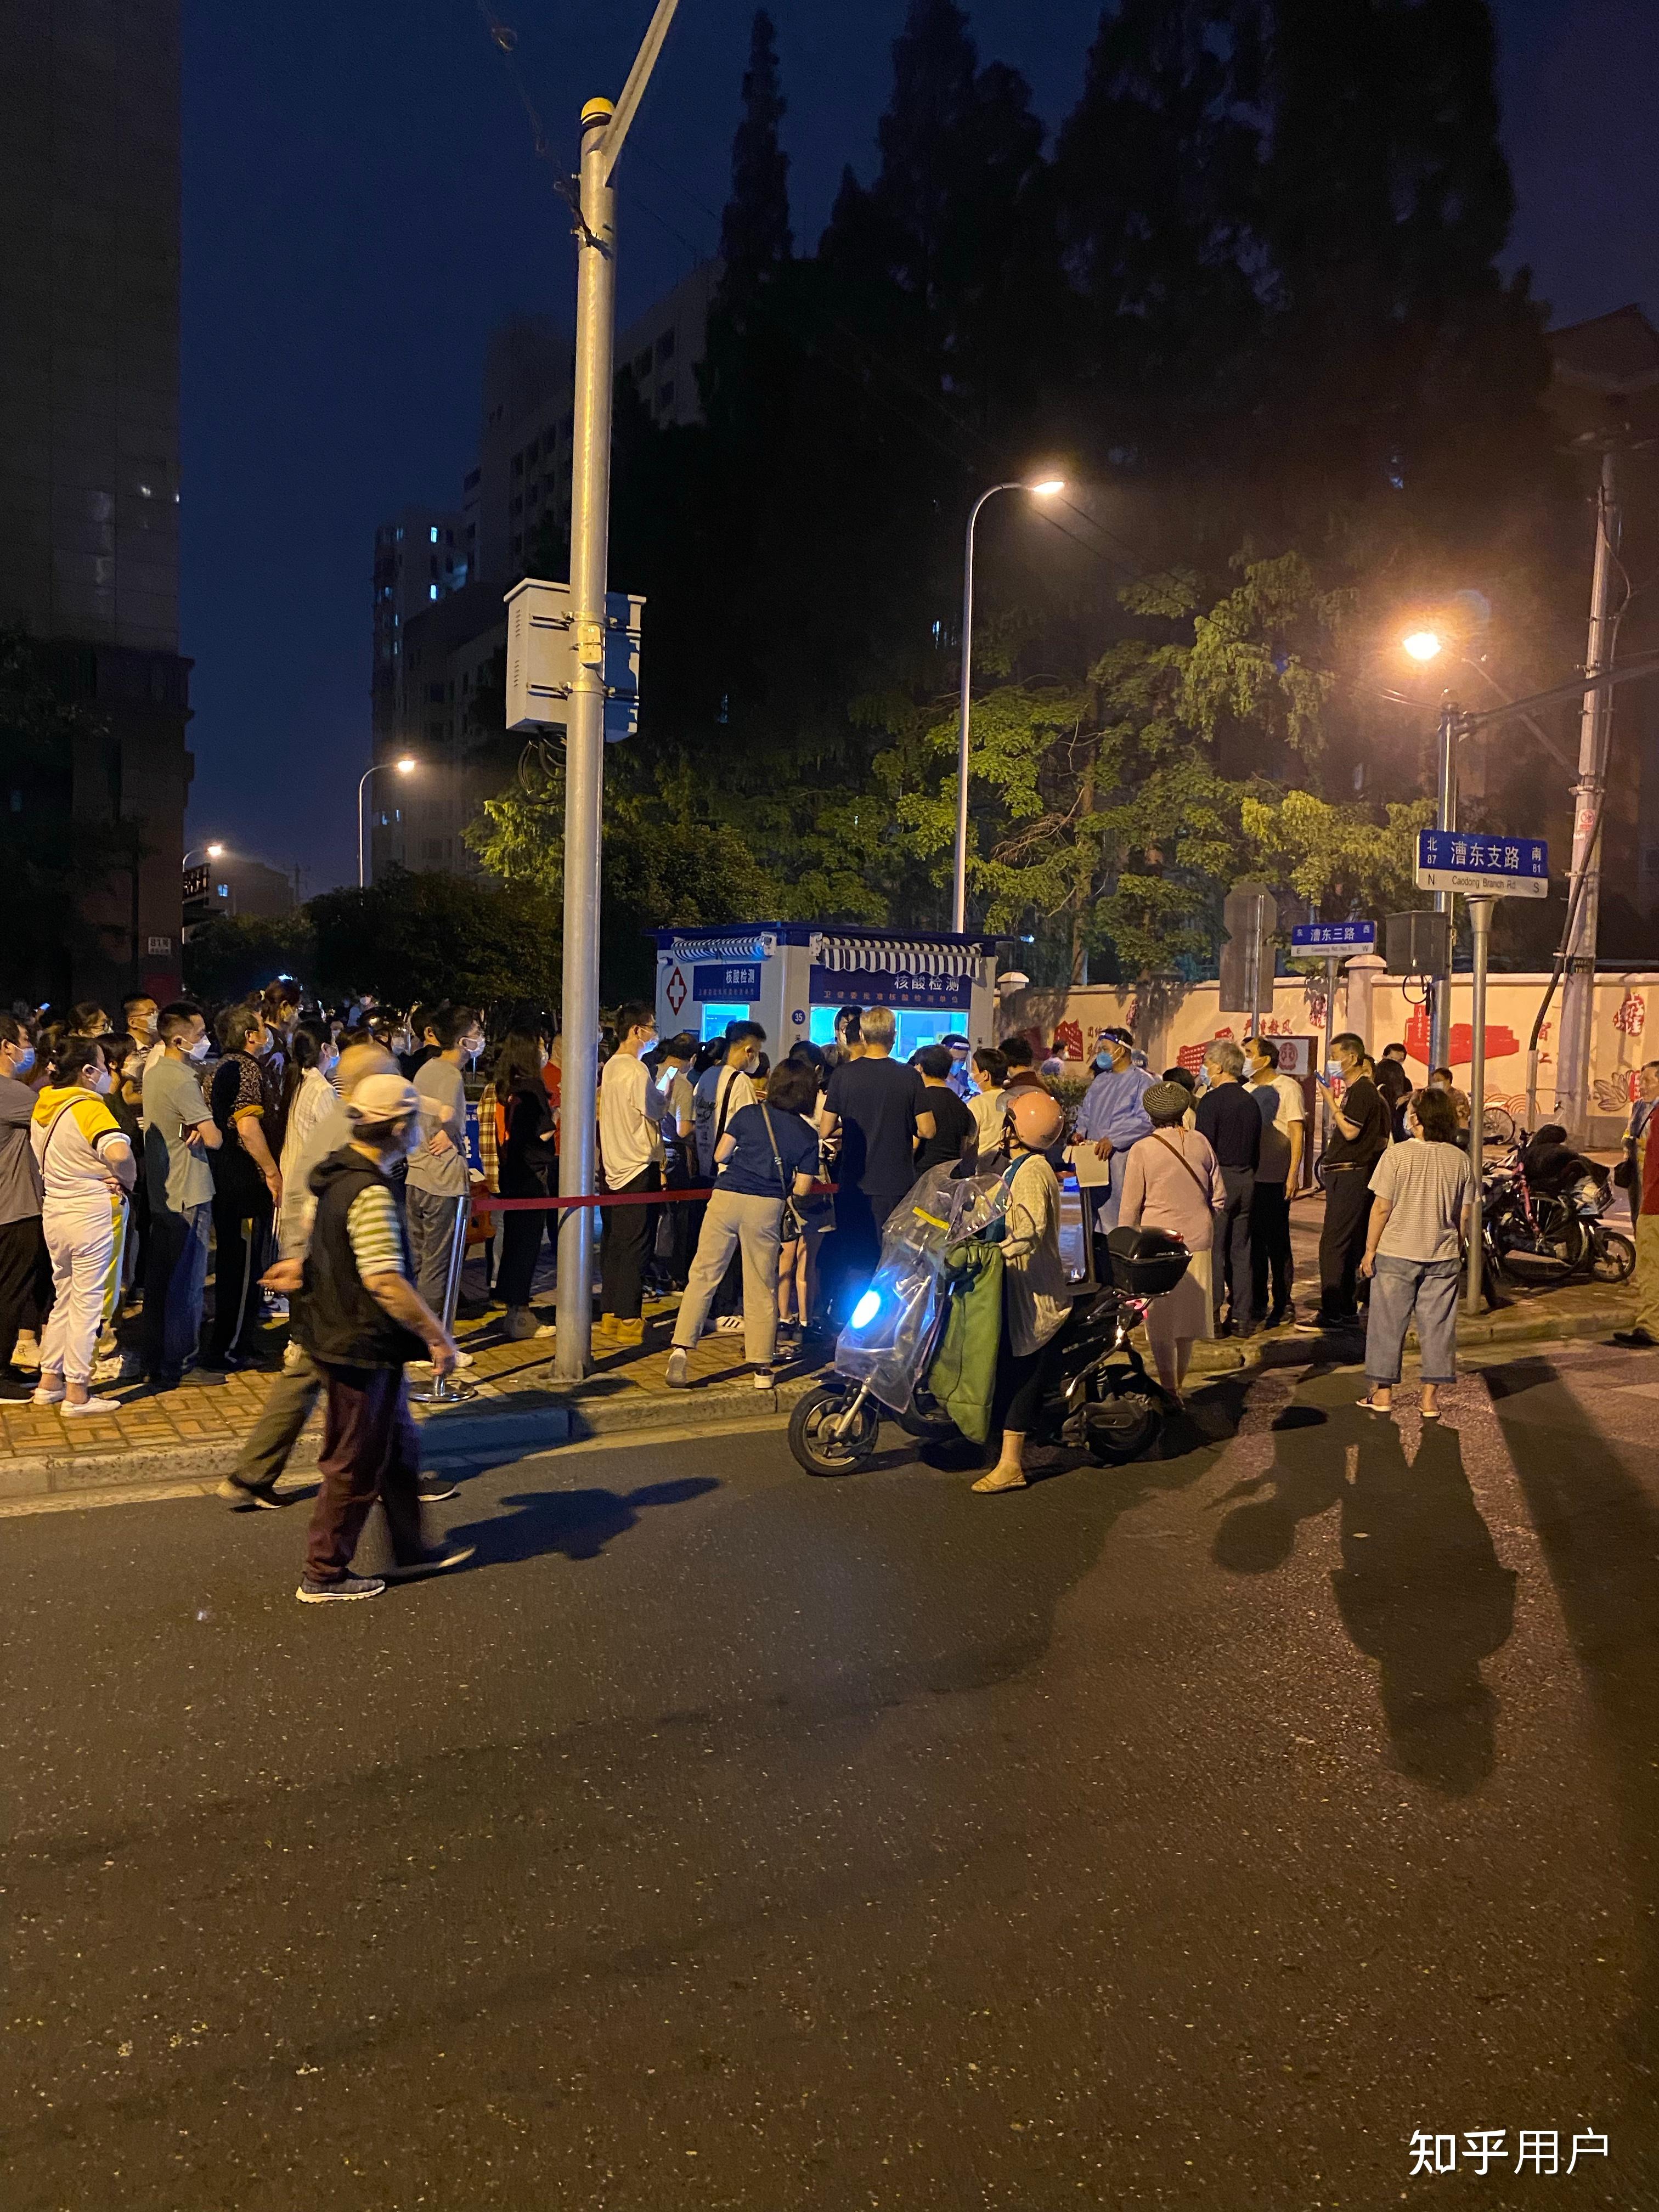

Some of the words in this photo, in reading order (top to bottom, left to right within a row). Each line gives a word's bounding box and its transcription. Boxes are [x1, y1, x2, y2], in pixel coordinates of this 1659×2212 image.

[1427, 837, 1437, 851] 北
[1451, 840, 1520, 869] 漕东支路
[1532, 846, 1541, 861] 南
[1427, 854, 1437, 864] 87
[1532, 864, 1541, 873] 81
[1428, 873, 1435, 885] N
[1452, 875, 1480, 889] Caodong
[1483, 878, 1504, 888] Branch
[1533, 882, 1539, 893] S
[1310, 927, 1355, 941] 漕东三路
[726, 968, 755, 984] 核酸检测
[894, 974, 960, 992] 核酸检测
[794, 1013, 803, 1022] 35
